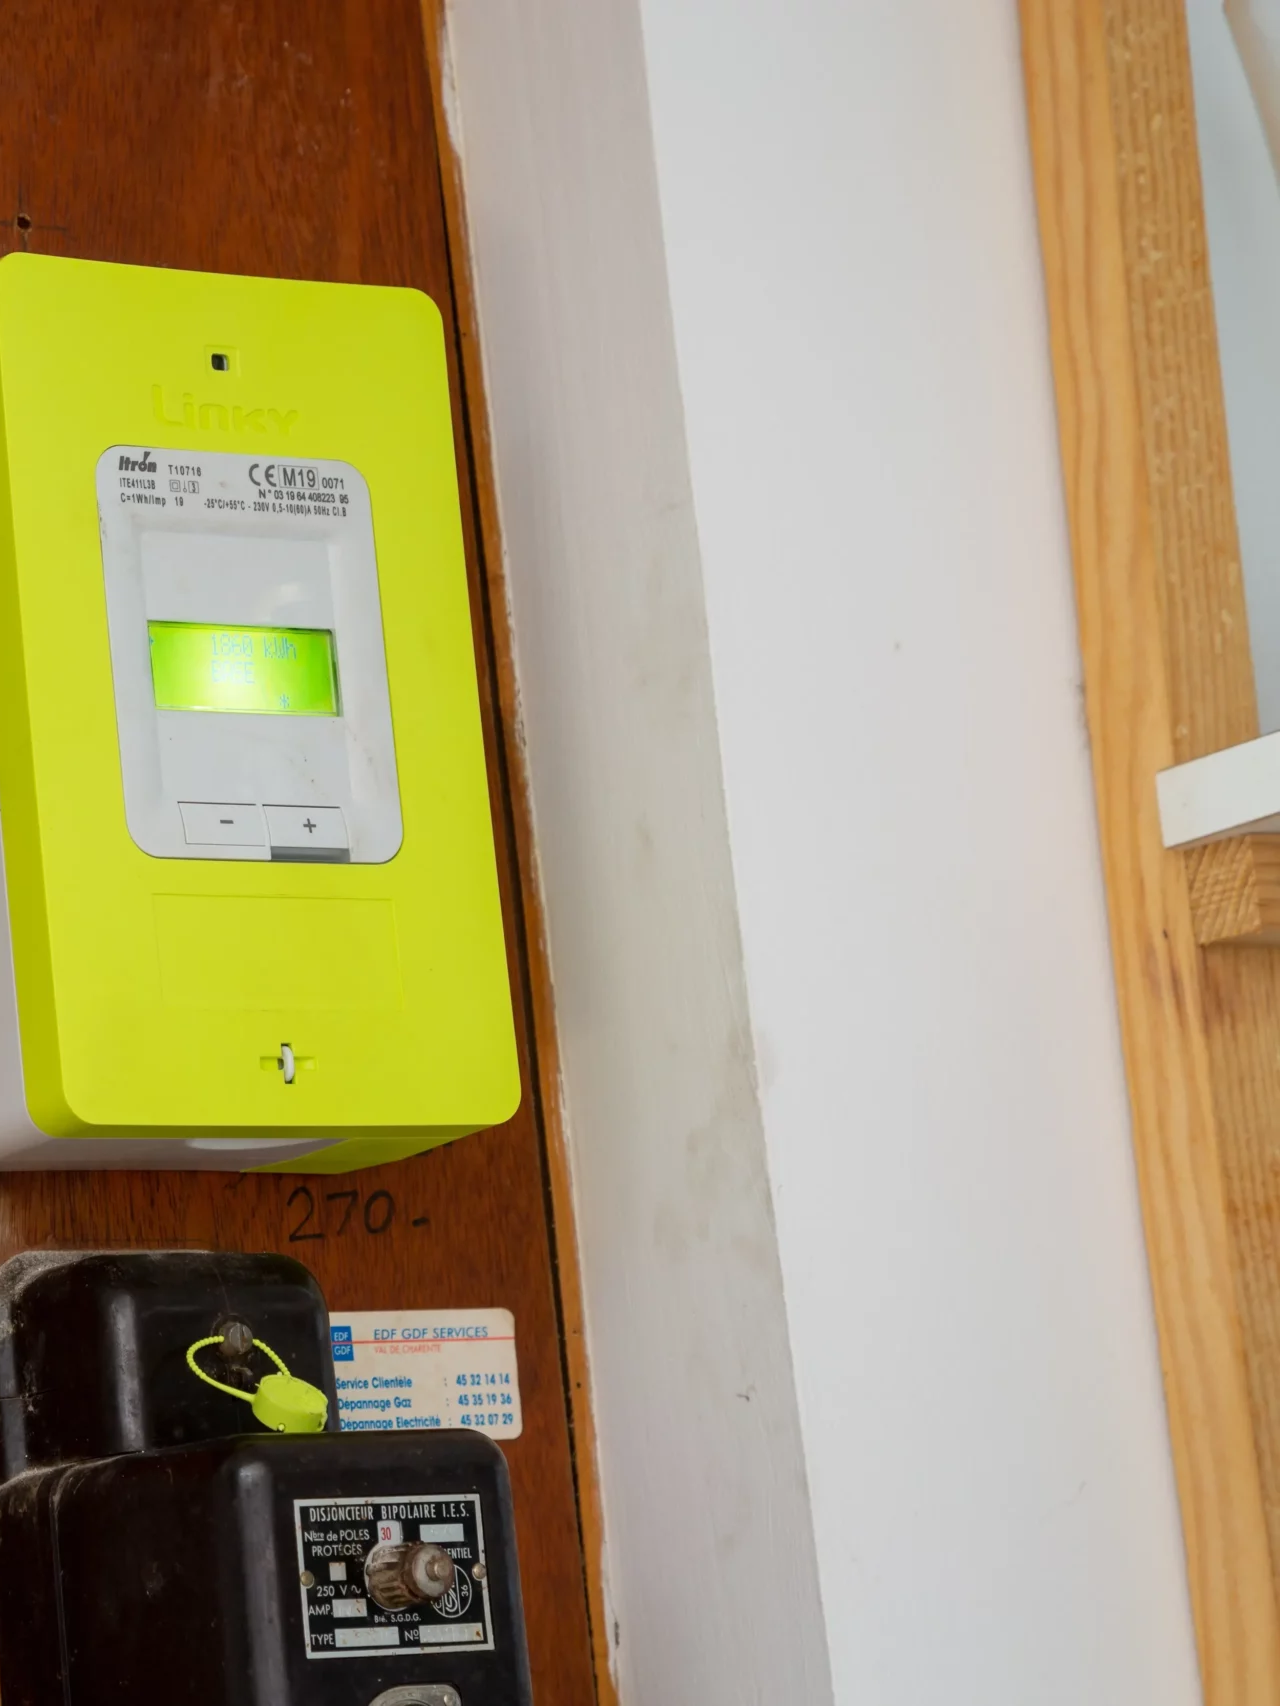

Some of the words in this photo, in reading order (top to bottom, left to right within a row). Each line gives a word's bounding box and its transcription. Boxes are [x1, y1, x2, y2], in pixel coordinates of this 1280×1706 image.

[168, 464, 201, 477] T10716
[283, 467, 316, 488] M19
[322, 477, 344, 490] 0071
[274, 490, 284, 500] 03
[253, 502, 270, 512] 230V
[313, 505, 330, 516] 50Hz
[263, 635, 297, 660] kWh
[334, 1332, 348, 1341] EDF
[373, 1329, 397, 1341] EDF
[402, 1328, 428, 1340] GDF
[433, 1326, 488, 1339] SERVICES
[334, 1346, 351, 1356] GDF
[374, 1345, 387, 1354] VAL
[390, 1345, 399, 1354] DE
[335, 1378, 369, 1389] Service
[456, 1374, 467, 1386] 45
[470, 1373, 481, 1386] 32
[485, 1373, 496, 1385] 14
[499, 1373, 510, 1384] 14
[337, 1397, 391, 1412] Dépannage
[394, 1397, 412, 1408] Gaz
[458, 1394, 469, 1406] 45
[486, 1393, 497, 1405] 19
[340, 1416, 393, 1431] Dépannage
[461, 1414, 472, 1426] 45
[488, 1413, 498, 1425] 07
[502, 1413, 513, 1424] 29
[310, 1506, 374, 1522] DISJONCTEUR
[381, 1504, 436, 1519] BIPOLAIRE
[442, 1503, 469, 1518] I.E.S.
[326, 1531, 338, 1541] de
[340, 1529, 370, 1541] POLES
[381, 1527, 391, 1541] 30
[317, 1586, 335, 1597] 250
[391, 1613, 421, 1623] S.G.D.G.
[311, 1634, 334, 1646] TYPE
